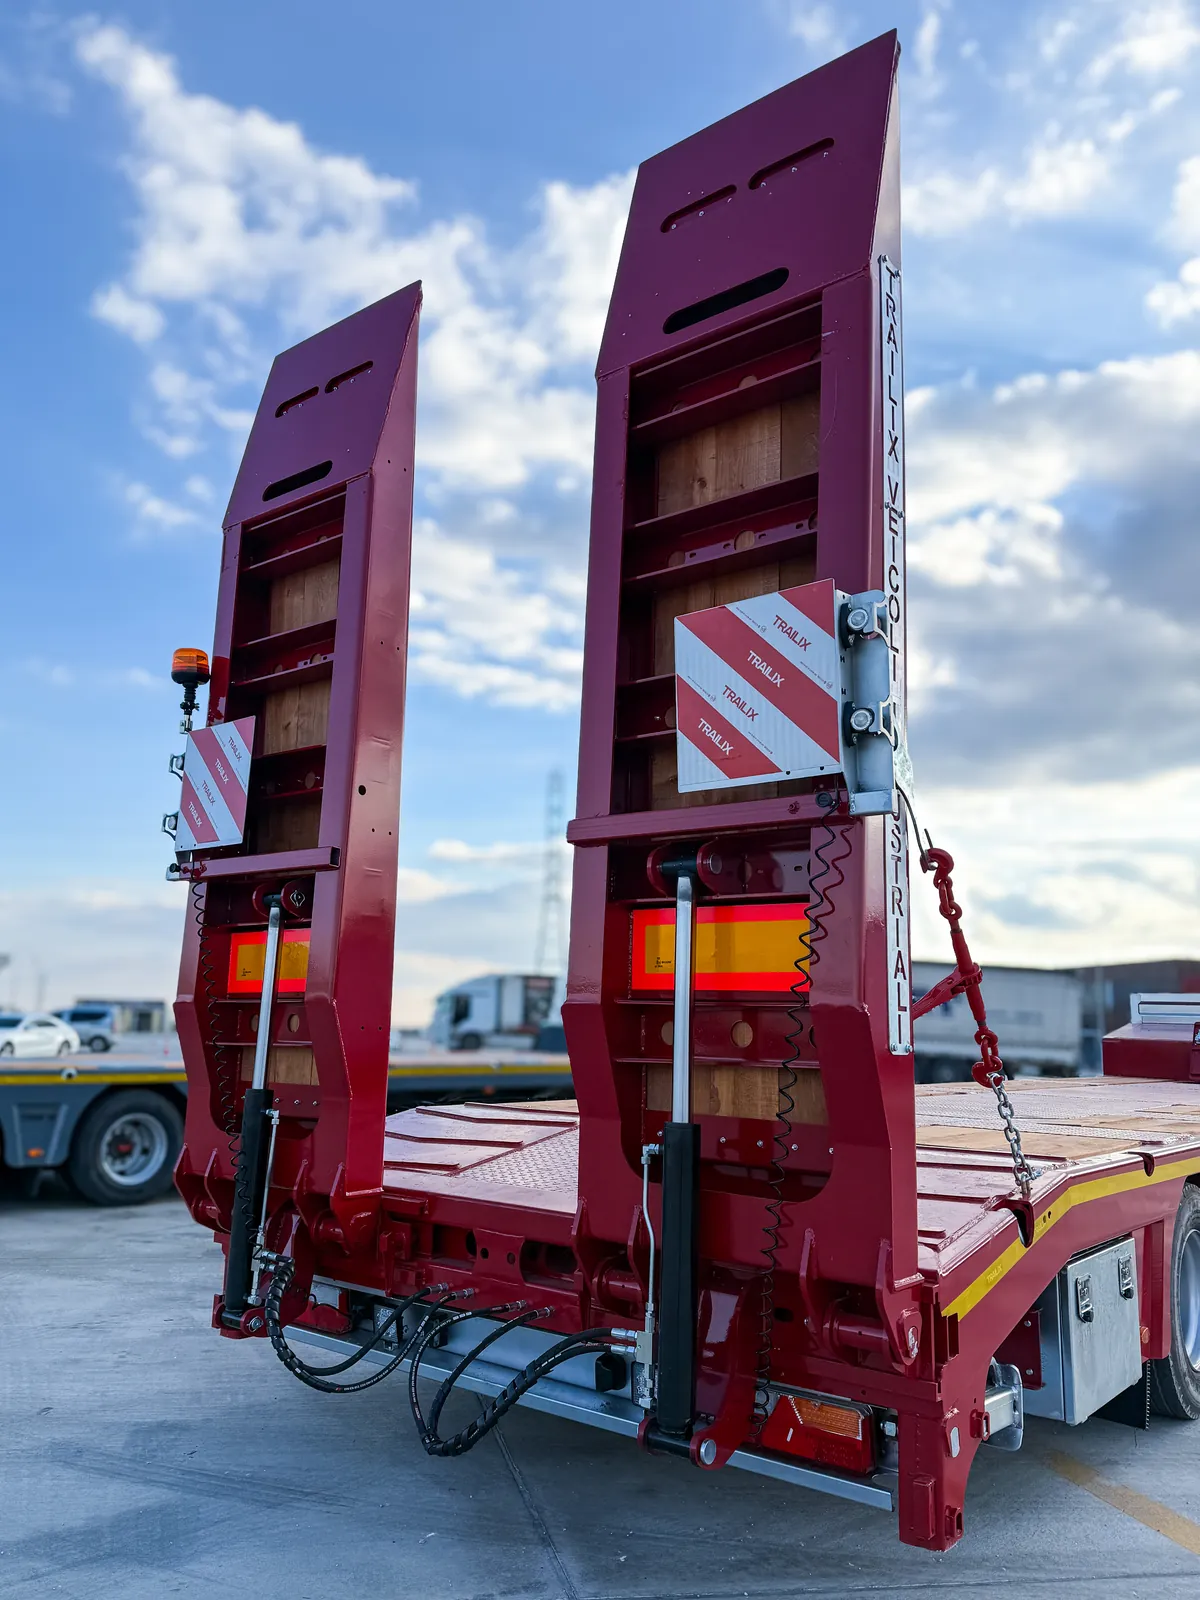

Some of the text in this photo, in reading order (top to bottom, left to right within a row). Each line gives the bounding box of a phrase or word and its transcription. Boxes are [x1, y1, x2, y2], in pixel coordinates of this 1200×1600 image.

[884, 267, 900, 463] TRAILIX
[887, 475, 901, 682] VEICOLI
[772, 615, 812, 652] TRAILIX
[747, 650, 785, 688] TRAILIX
[722, 685, 759, 722] TRAILIX
[228, 736, 243, 762] TRAILIX
[697, 717, 734, 756] TRAILIX
[215, 758, 229, 784] TRAILIX
[201, 780, 216, 806] TRAILIX
[188, 801, 202, 828] TRAILIX
